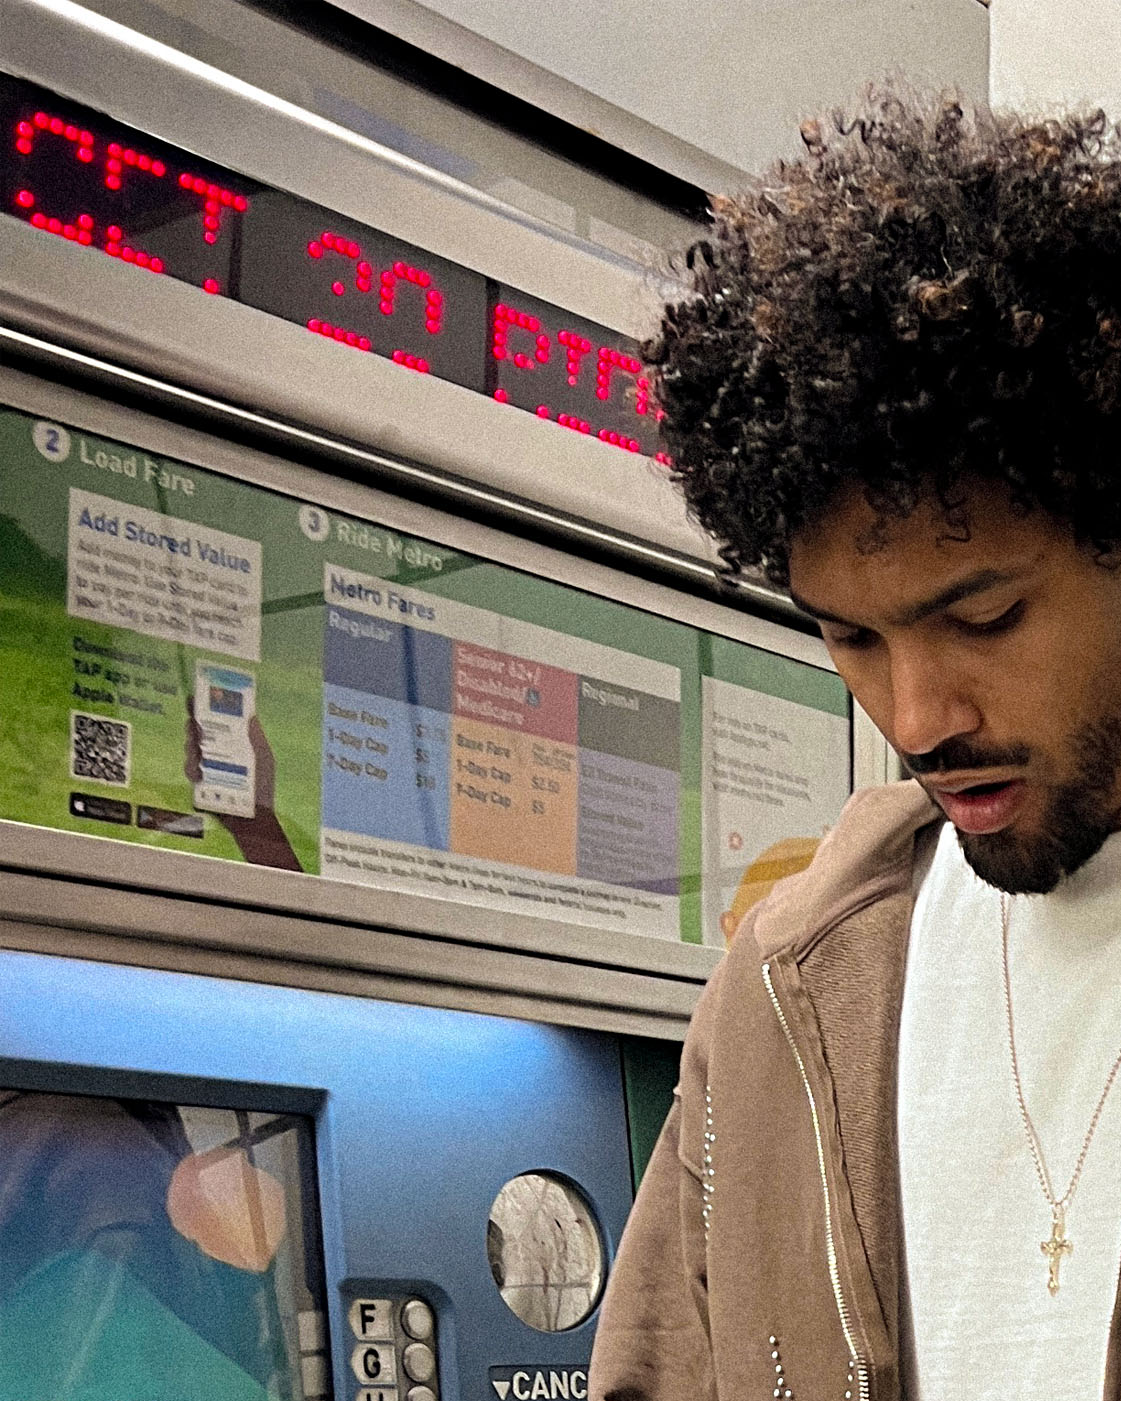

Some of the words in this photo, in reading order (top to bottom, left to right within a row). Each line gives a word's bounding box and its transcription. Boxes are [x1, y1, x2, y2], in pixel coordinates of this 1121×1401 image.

[494, 304, 674, 466] RID
[45, 429, 60, 453] 2
[79, 439, 137, 479] Load
[143, 460, 196, 496] Fare
[78, 508, 120, 537] Add
[125, 520, 192, 558] Stored
[195, 539, 253, 574] Value
[308, 510, 322, 533] 3
[336, 522, 382, 553] Ride
[385, 536, 443, 572] Metro
[330, 573, 383, 607] Metro
[387, 590, 436, 622] Fares
[328, 610, 393, 643] Regular
[360, 1303, 376, 1334] F
[363, 1348, 381, 1379] G
